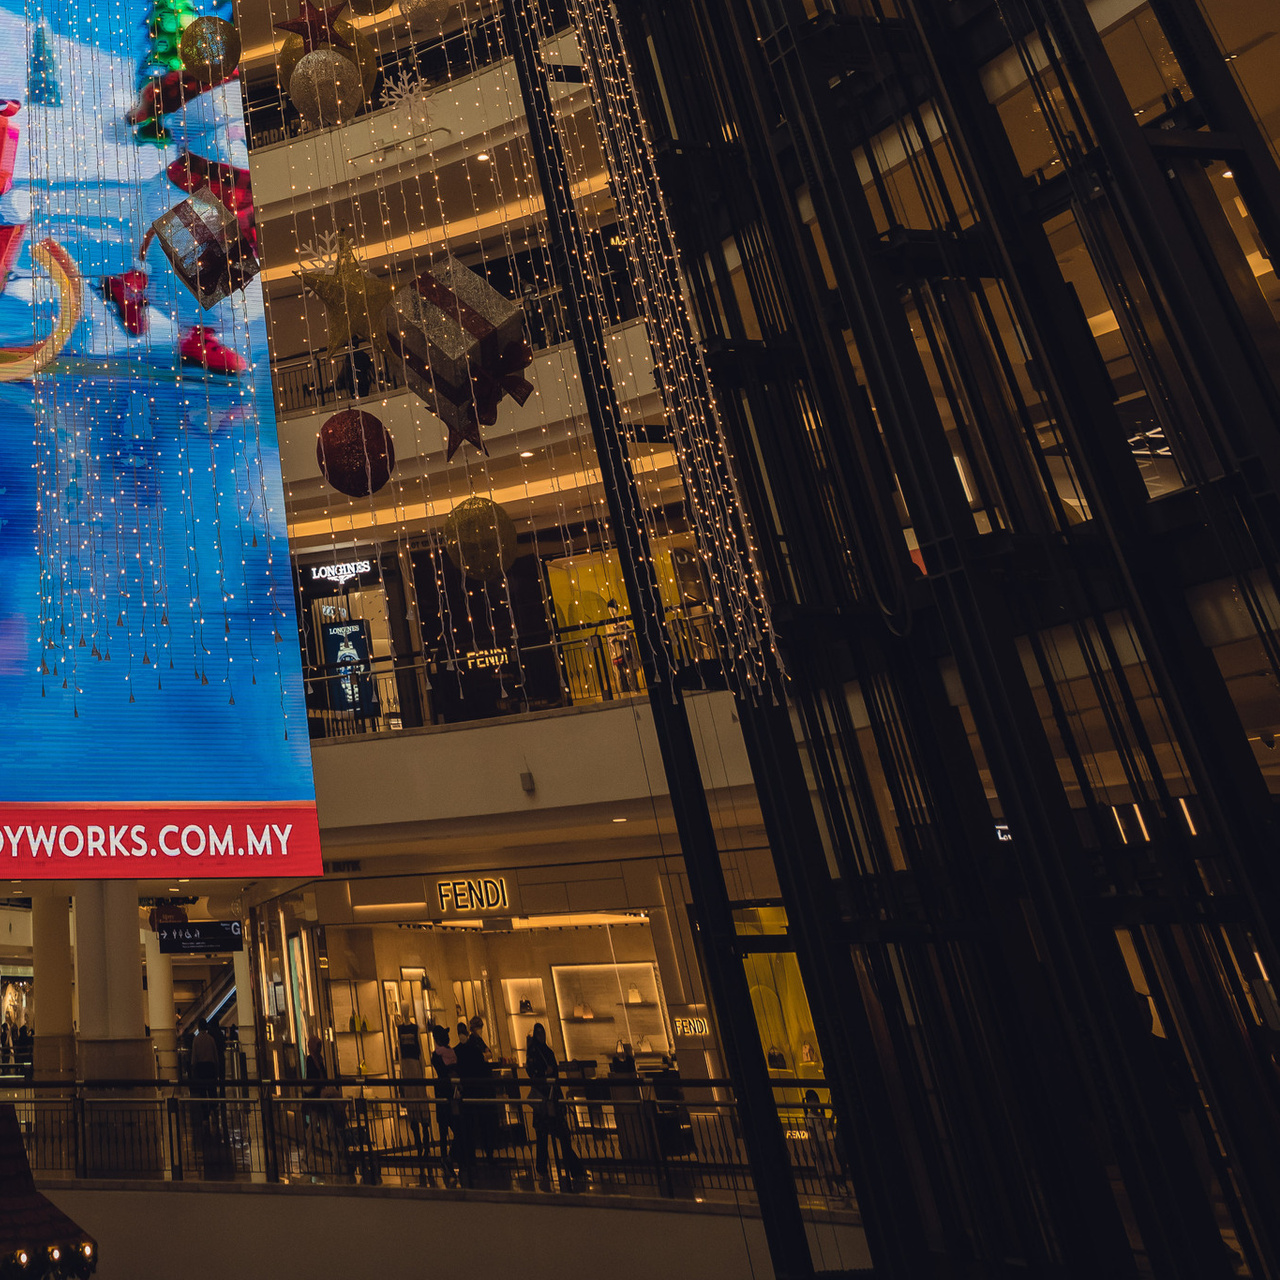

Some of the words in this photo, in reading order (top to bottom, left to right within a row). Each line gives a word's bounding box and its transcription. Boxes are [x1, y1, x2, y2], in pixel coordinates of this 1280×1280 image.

[311, 560, 372, 581] LONGINES
[328, 624, 360, 636] LONGINES
[466, 648, 510, 669] FENDI
[437, 877, 509, 911] FENDI
[231, 922, 241, 935] G
[675, 1018, 709, 1035] FENDI
